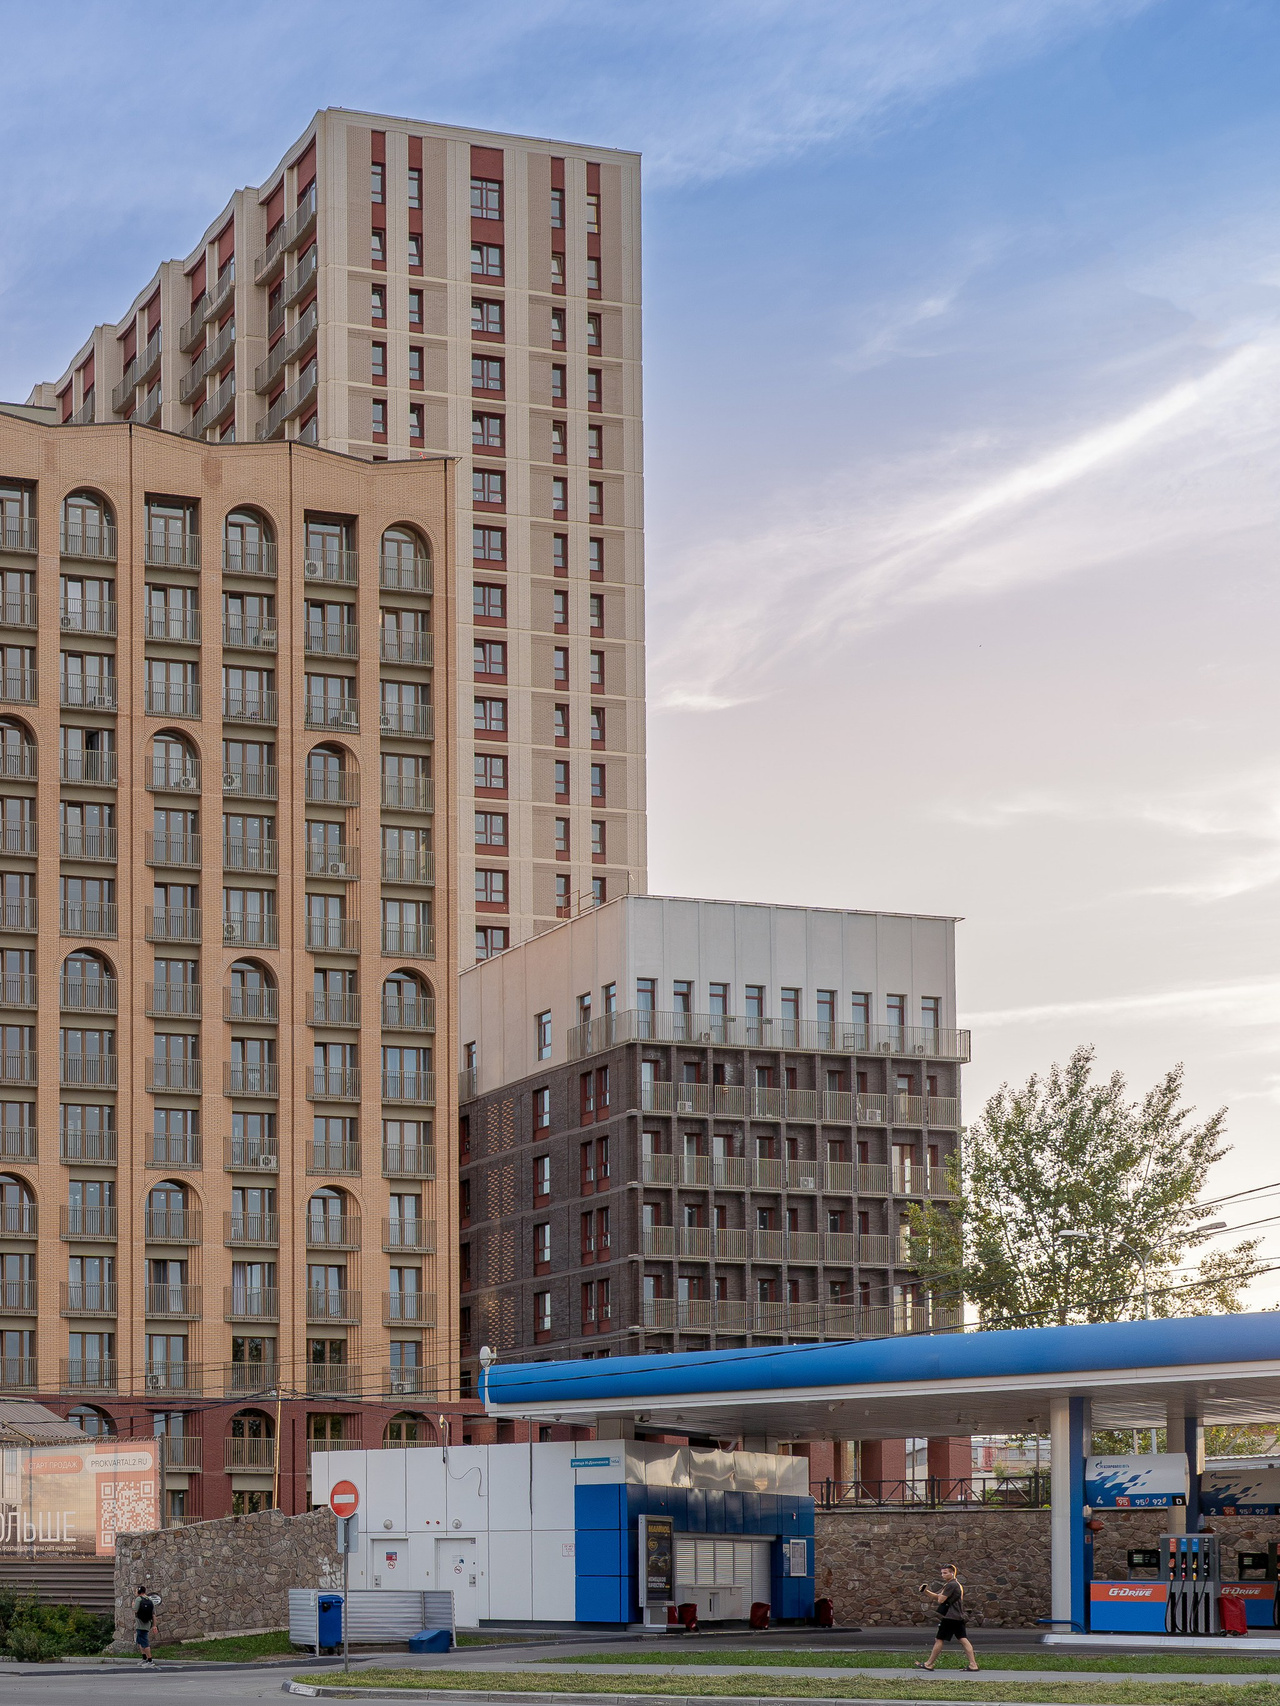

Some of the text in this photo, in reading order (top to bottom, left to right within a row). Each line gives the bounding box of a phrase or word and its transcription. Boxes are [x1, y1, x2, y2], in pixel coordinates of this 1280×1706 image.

[28, 1460, 78, 1470] СТАРТ ПРОДАЖ
[91, 1458, 148, 1467] PROKVARTAL2.RU
[1096, 1496, 1104, 1504] 4
